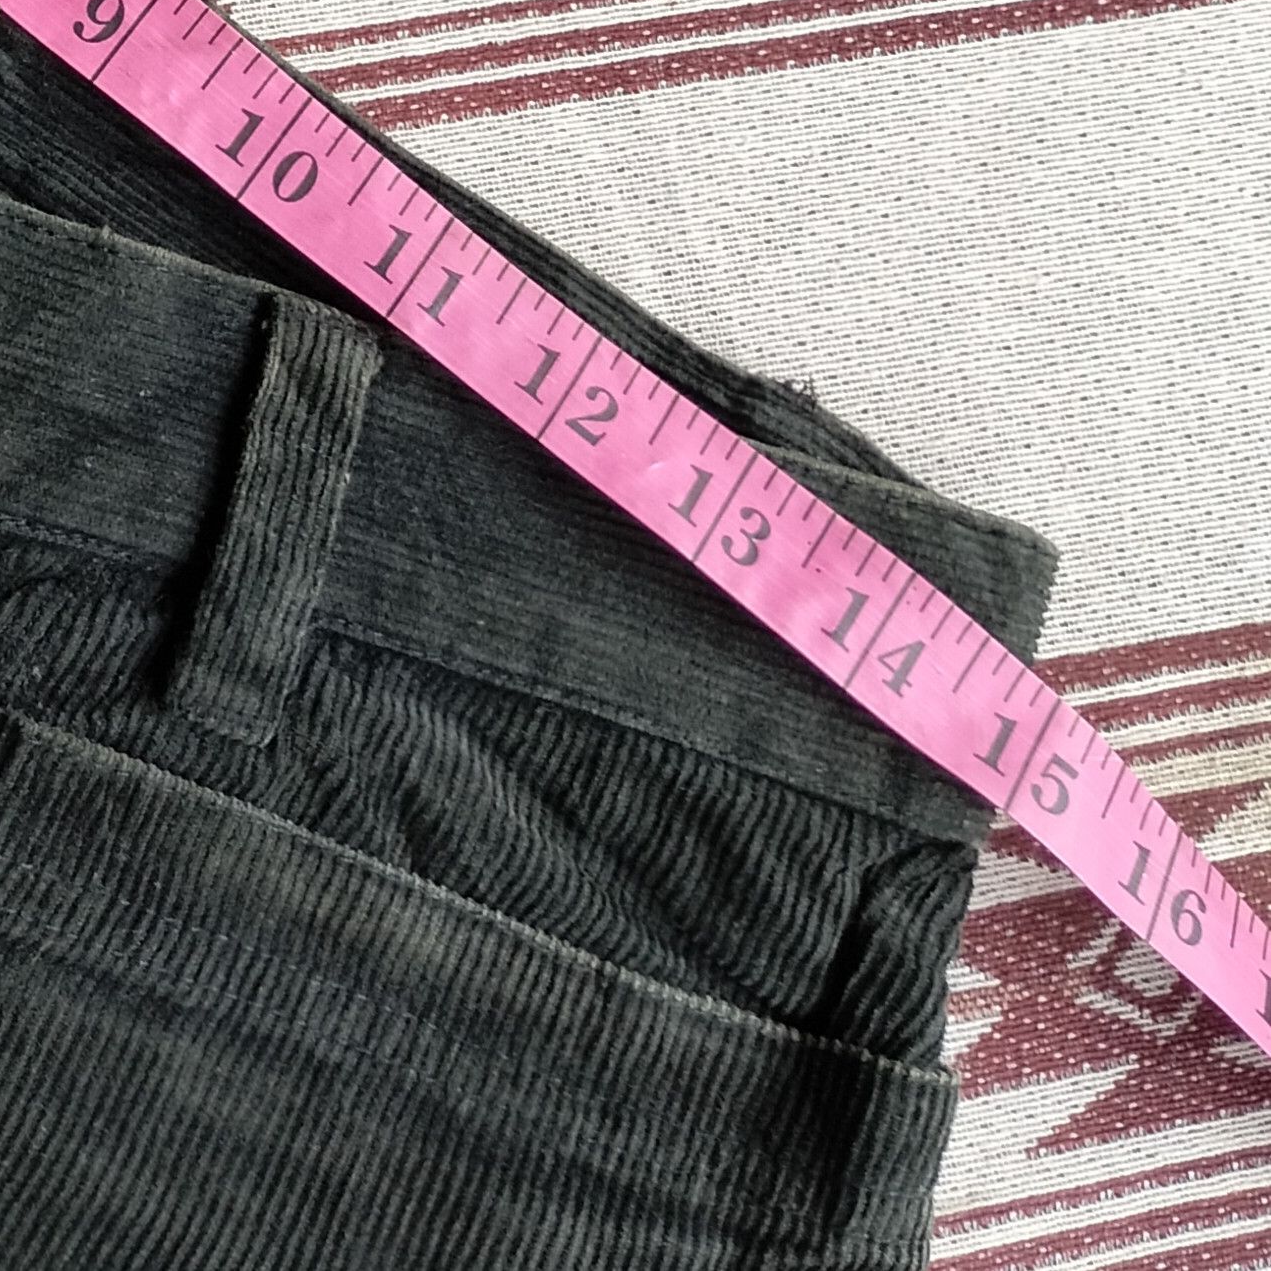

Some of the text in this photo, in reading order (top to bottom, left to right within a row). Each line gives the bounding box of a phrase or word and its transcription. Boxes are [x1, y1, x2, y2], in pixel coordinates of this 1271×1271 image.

[214, 107, 320, 204] 10
[362, 223, 464, 328] 11
[513, 343, 620, 448] 12
[667, 463, 772, 567] 13
[821, 585, 927, 698] 14
[973, 711, 1079, 816] 15
[1117, 840, 1207, 947] 16
